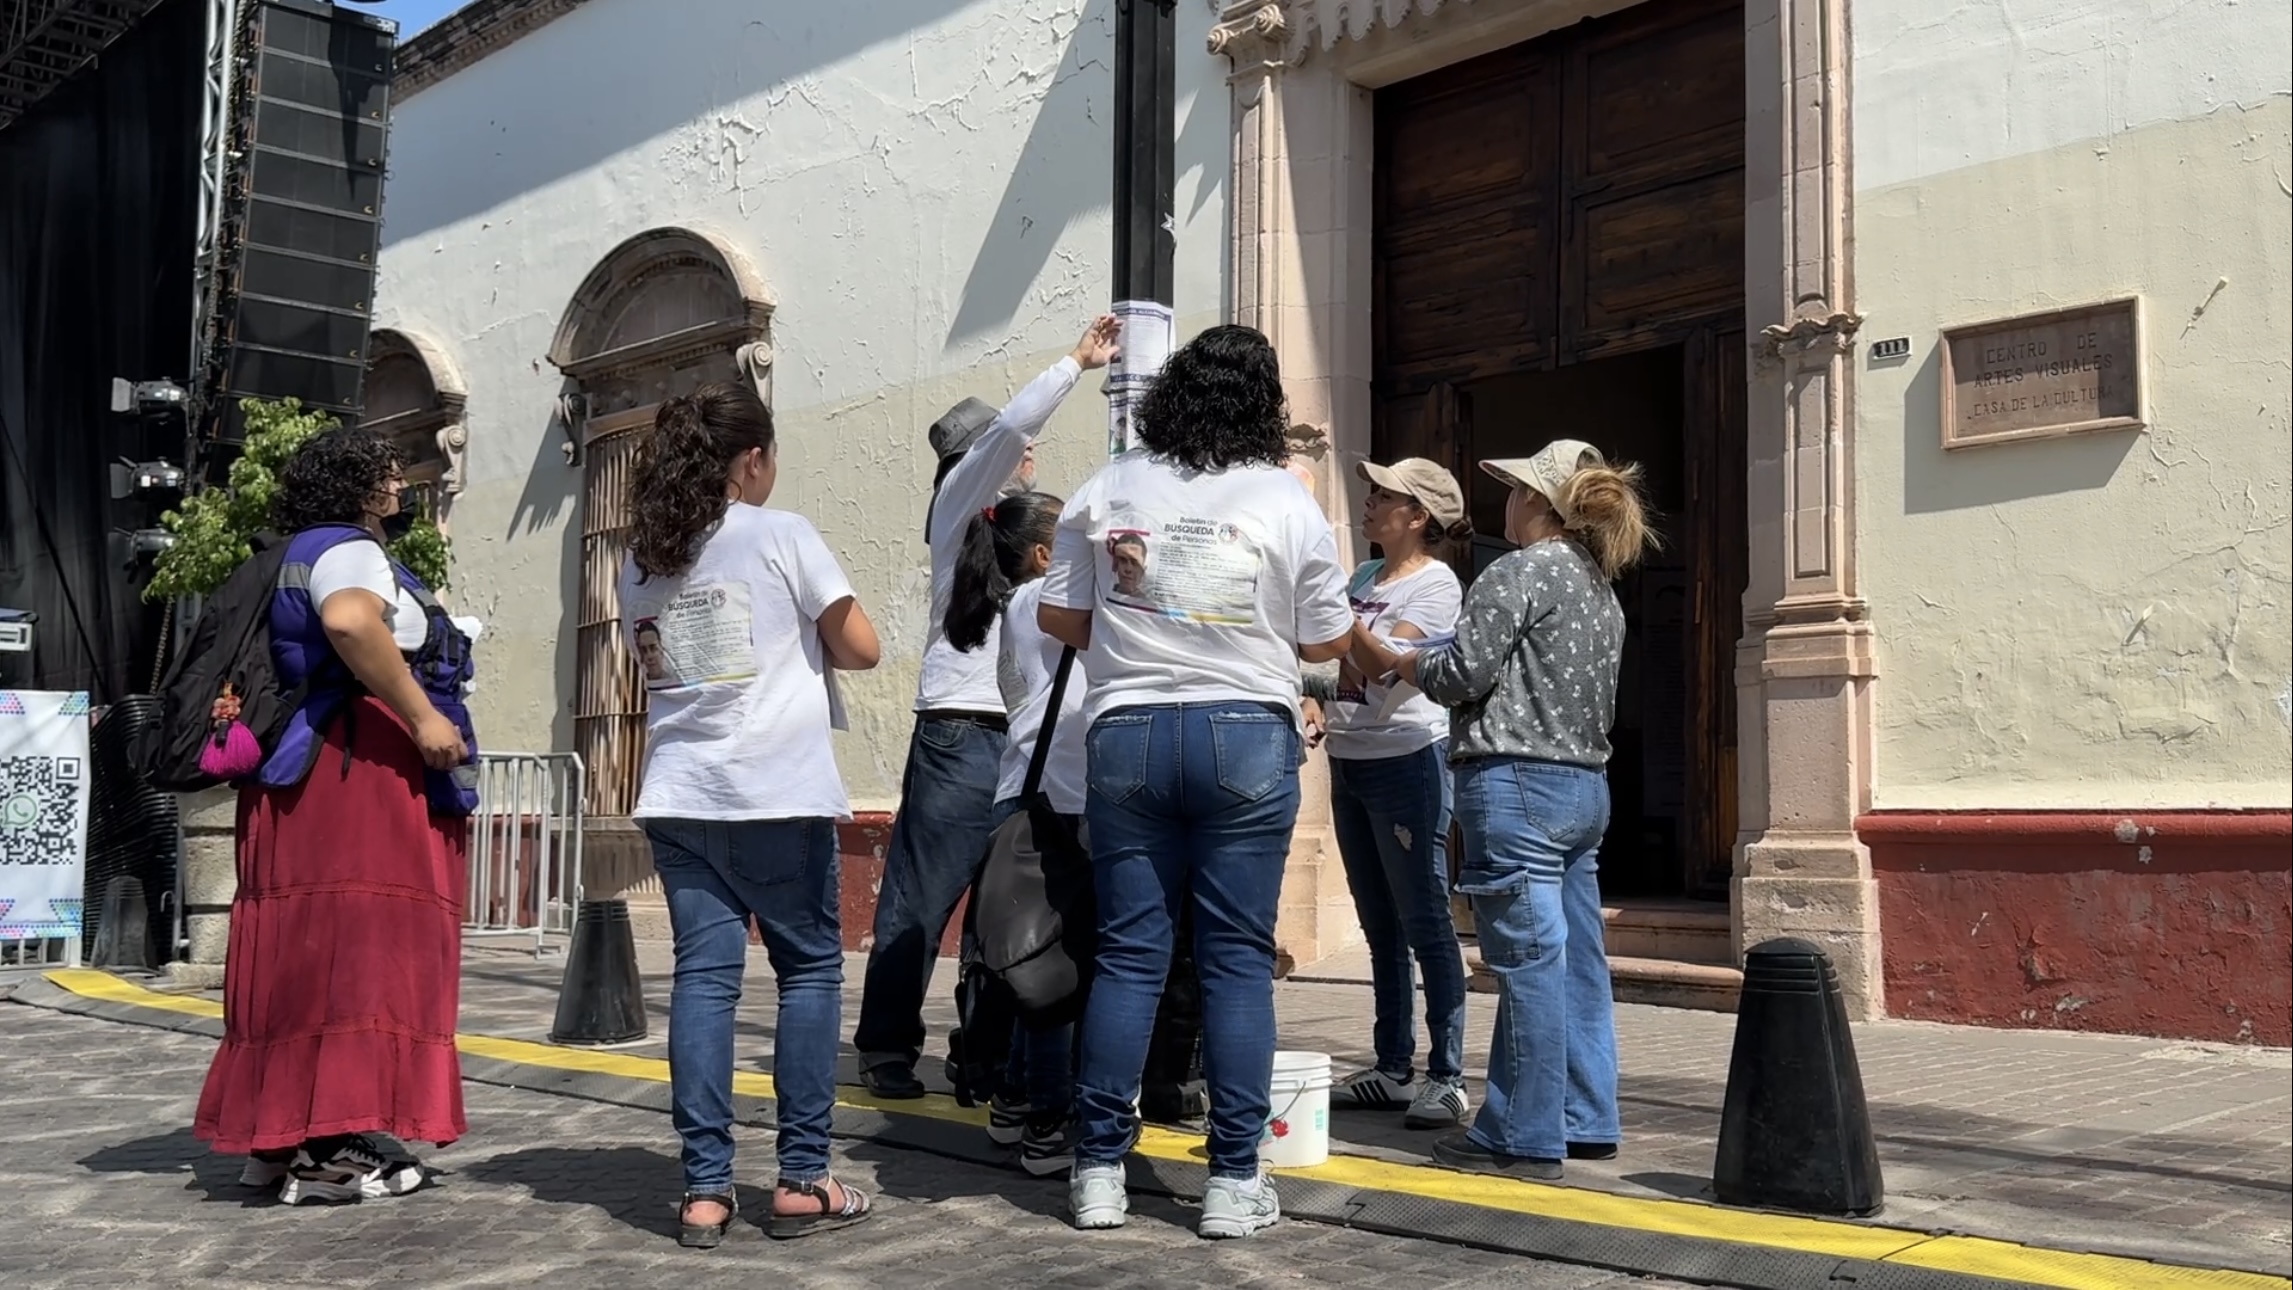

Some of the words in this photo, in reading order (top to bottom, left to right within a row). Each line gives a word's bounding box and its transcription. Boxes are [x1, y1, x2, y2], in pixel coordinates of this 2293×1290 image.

[1986, 341, 2047, 364] CENTRO
[2077, 332, 2097, 350] DE
[1974, 367, 2024, 388] ARTES
[2035, 353, 2113, 379] VISUALES
[1973, 401, 2008, 417] CASA
[2012, 397, 2027, 412] DE
[2033, 394, 2049, 409] LA
[2054, 385, 2114, 405] CULTURA
[1171, 534, 1181, 542] de
[1182, 535, 1217, 546] Personas
